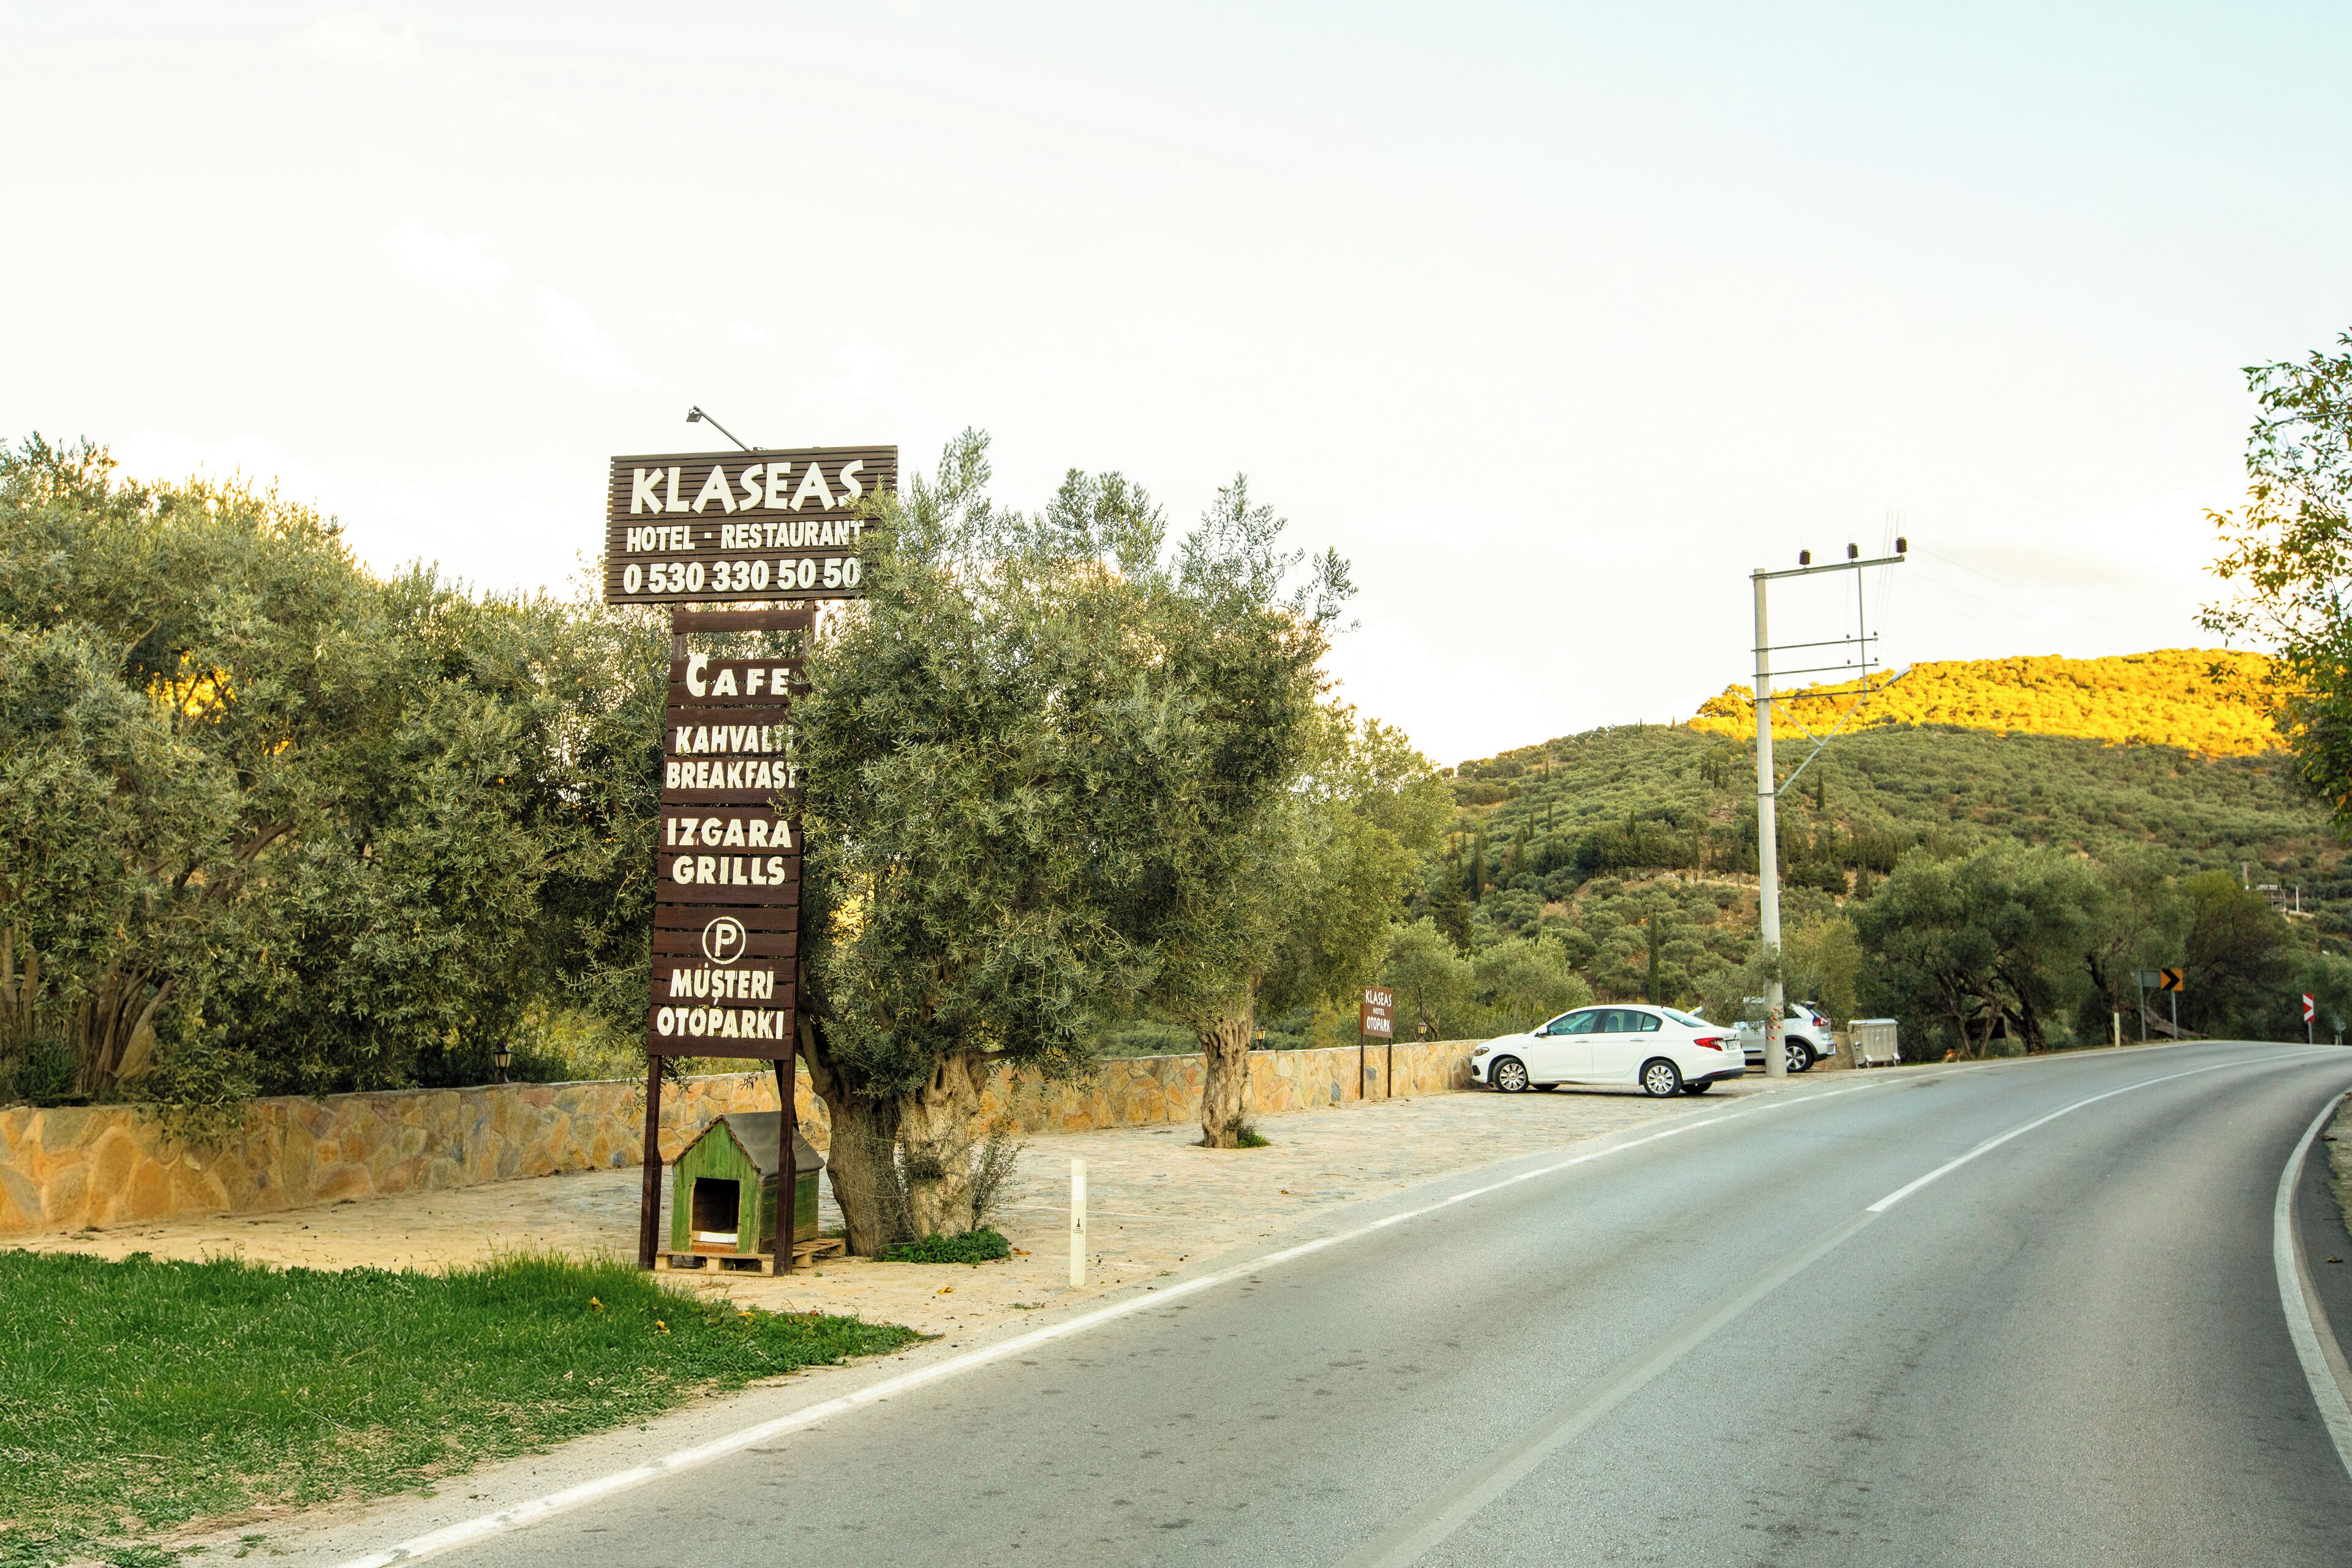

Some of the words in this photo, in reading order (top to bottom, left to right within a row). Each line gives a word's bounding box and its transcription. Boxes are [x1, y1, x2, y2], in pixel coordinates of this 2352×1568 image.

[630, 460, 864, 514] KLASEAS
[626, 526, 695, 552] HOTEL
[721, 521, 865, 549] RESTAURANT
[624, 564, 643, 594] 0
[648, 562, 704, 593] 530
[712, 560, 769, 592] 330
[777, 558, 816, 590] 50
[823, 557, 861, 589] 50
[687, 654, 790, 697] CAFE
[666, 761, 799, 789] BREAKFAST
[667, 818, 792, 848] IZGARA
[673, 856, 785, 886] GRILLS
[1365, 989, 1392, 1008] KLASEAS
[1373, 1007, 1385, 1016] HOTEL
[657, 1007, 785, 1039] OTOPARKI
[1366, 1016, 1390, 1033] OTOPARK
